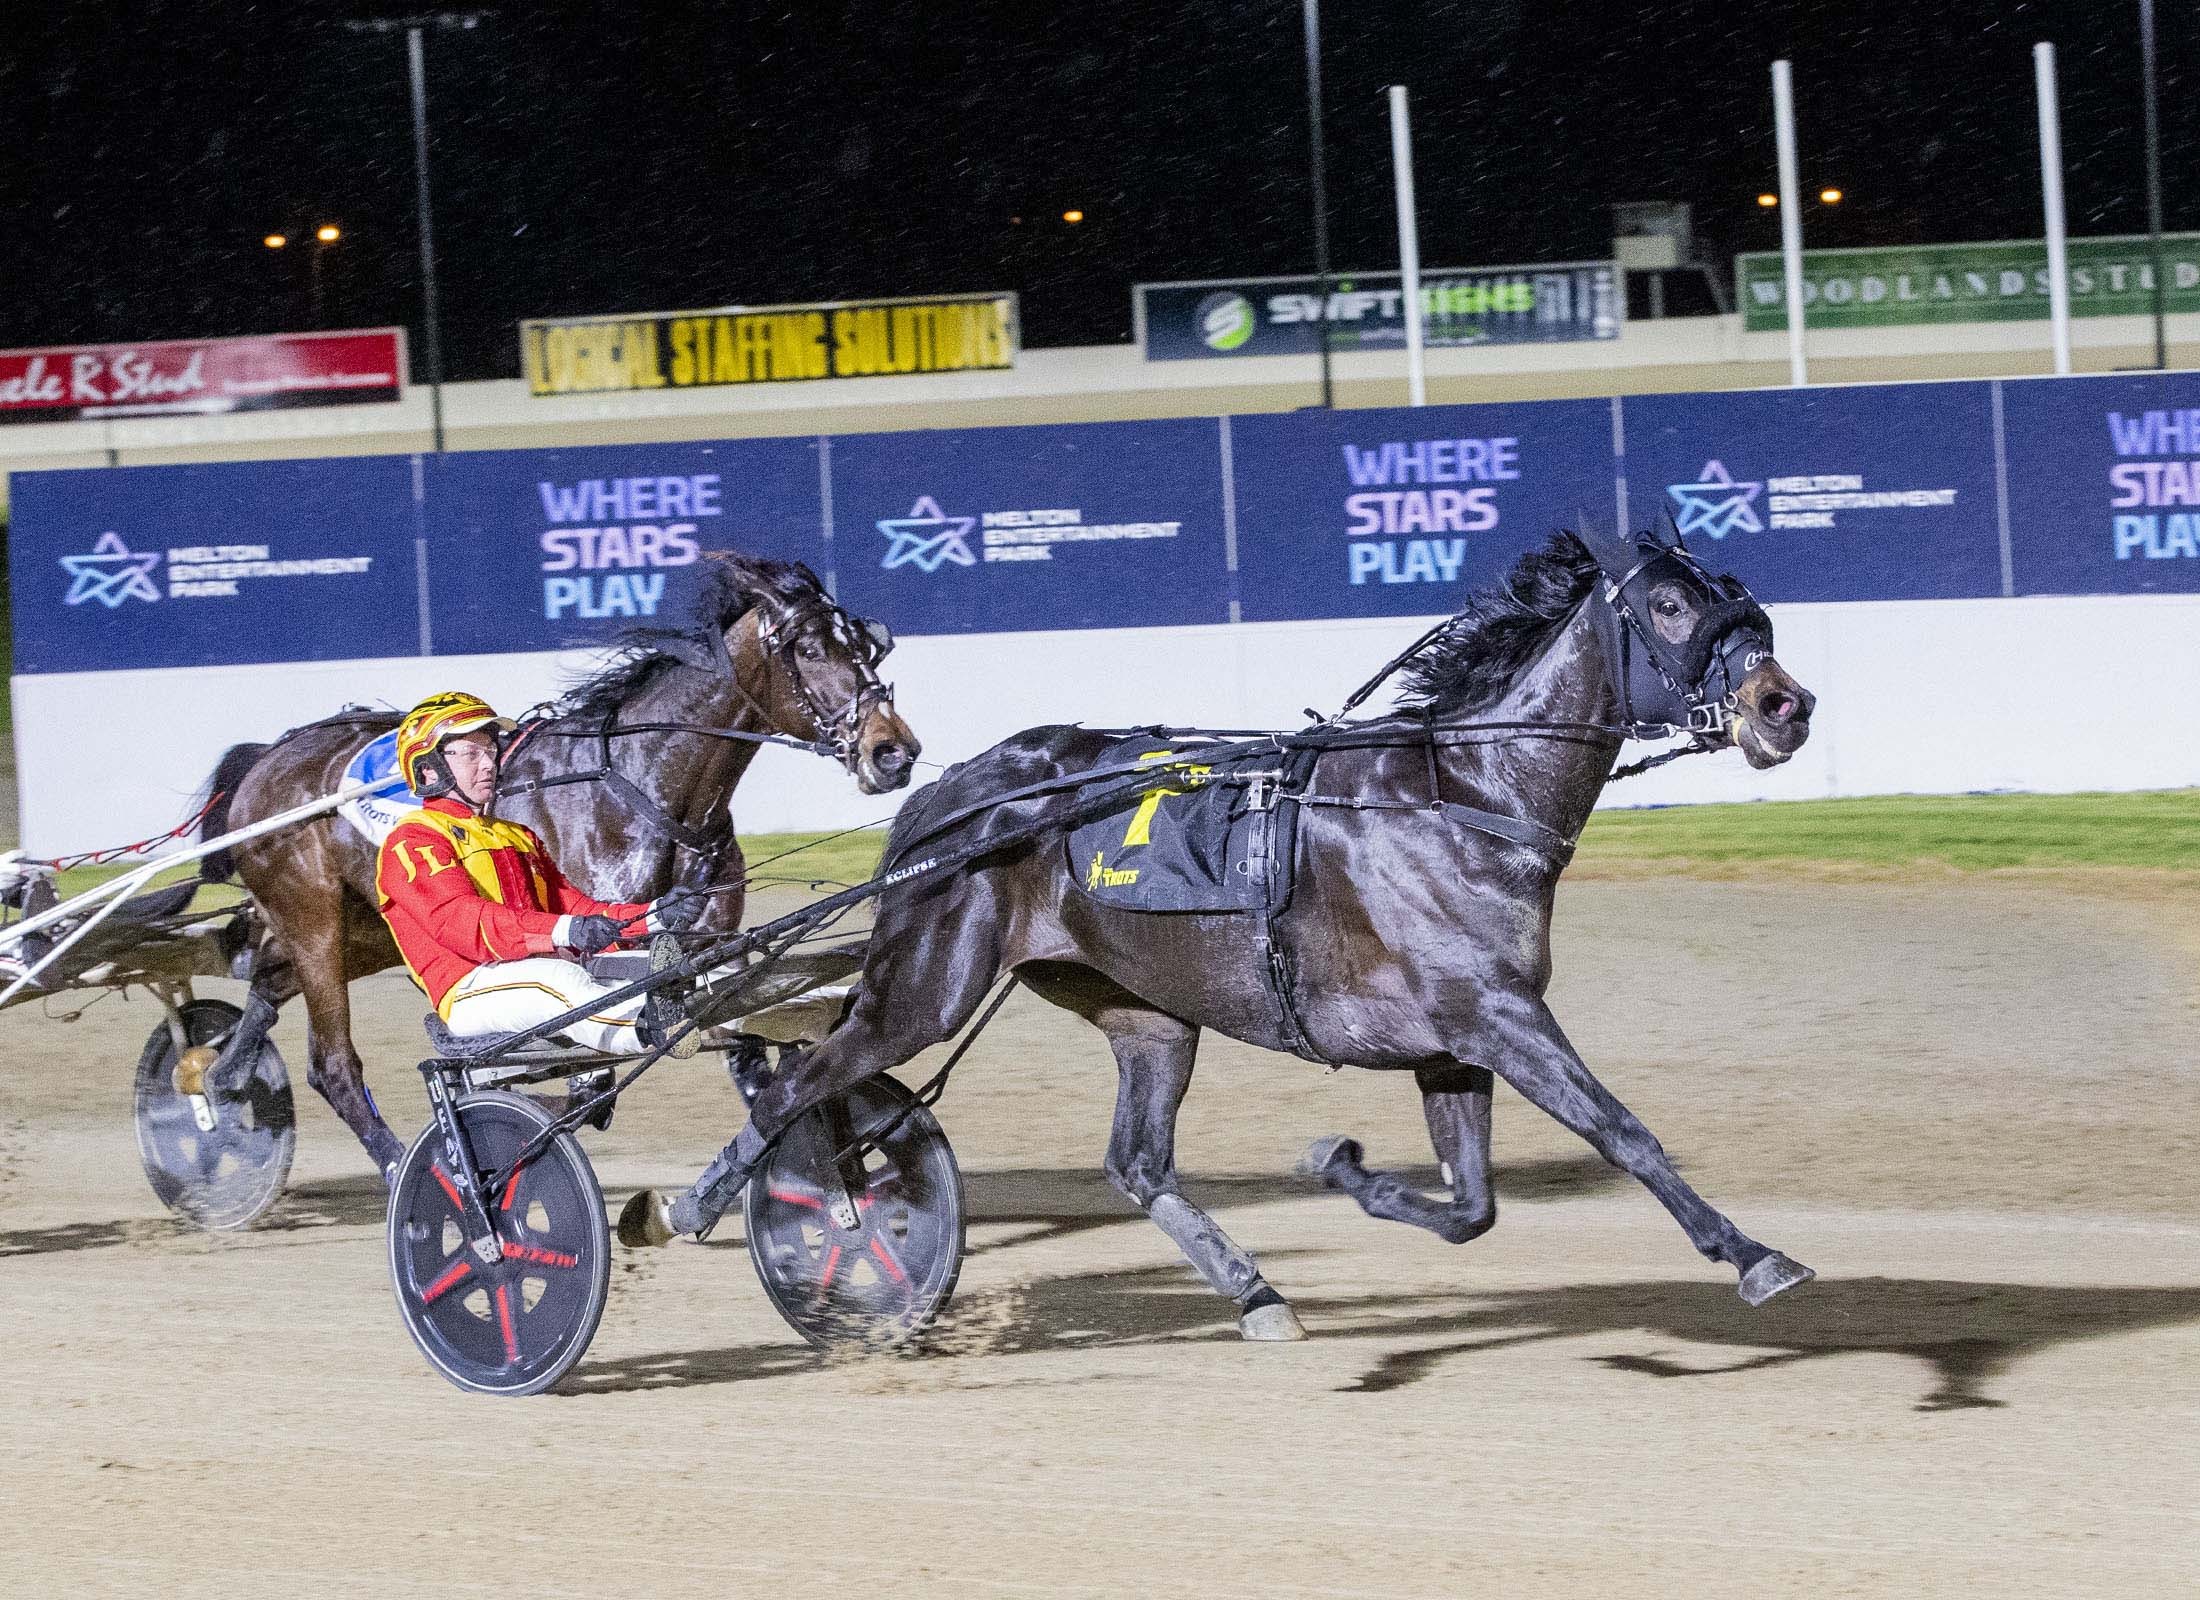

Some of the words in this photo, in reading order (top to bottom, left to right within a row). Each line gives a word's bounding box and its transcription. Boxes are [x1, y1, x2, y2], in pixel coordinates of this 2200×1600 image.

[72, 355, 104, 400] R
[1343, 437, 1521, 486] WHERE
[2109, 461, 2200, 508] STA
[539, 474, 723, 523] WHERE
[1345, 488, 1499, 535] STARS
[540, 523, 701, 571] STARS
[2112, 513, 2200, 560] PLA
[1349, 538, 1467, 584] PLAY
[544, 573, 666, 620] PLAY
[391, 840, 456, 883] JL
